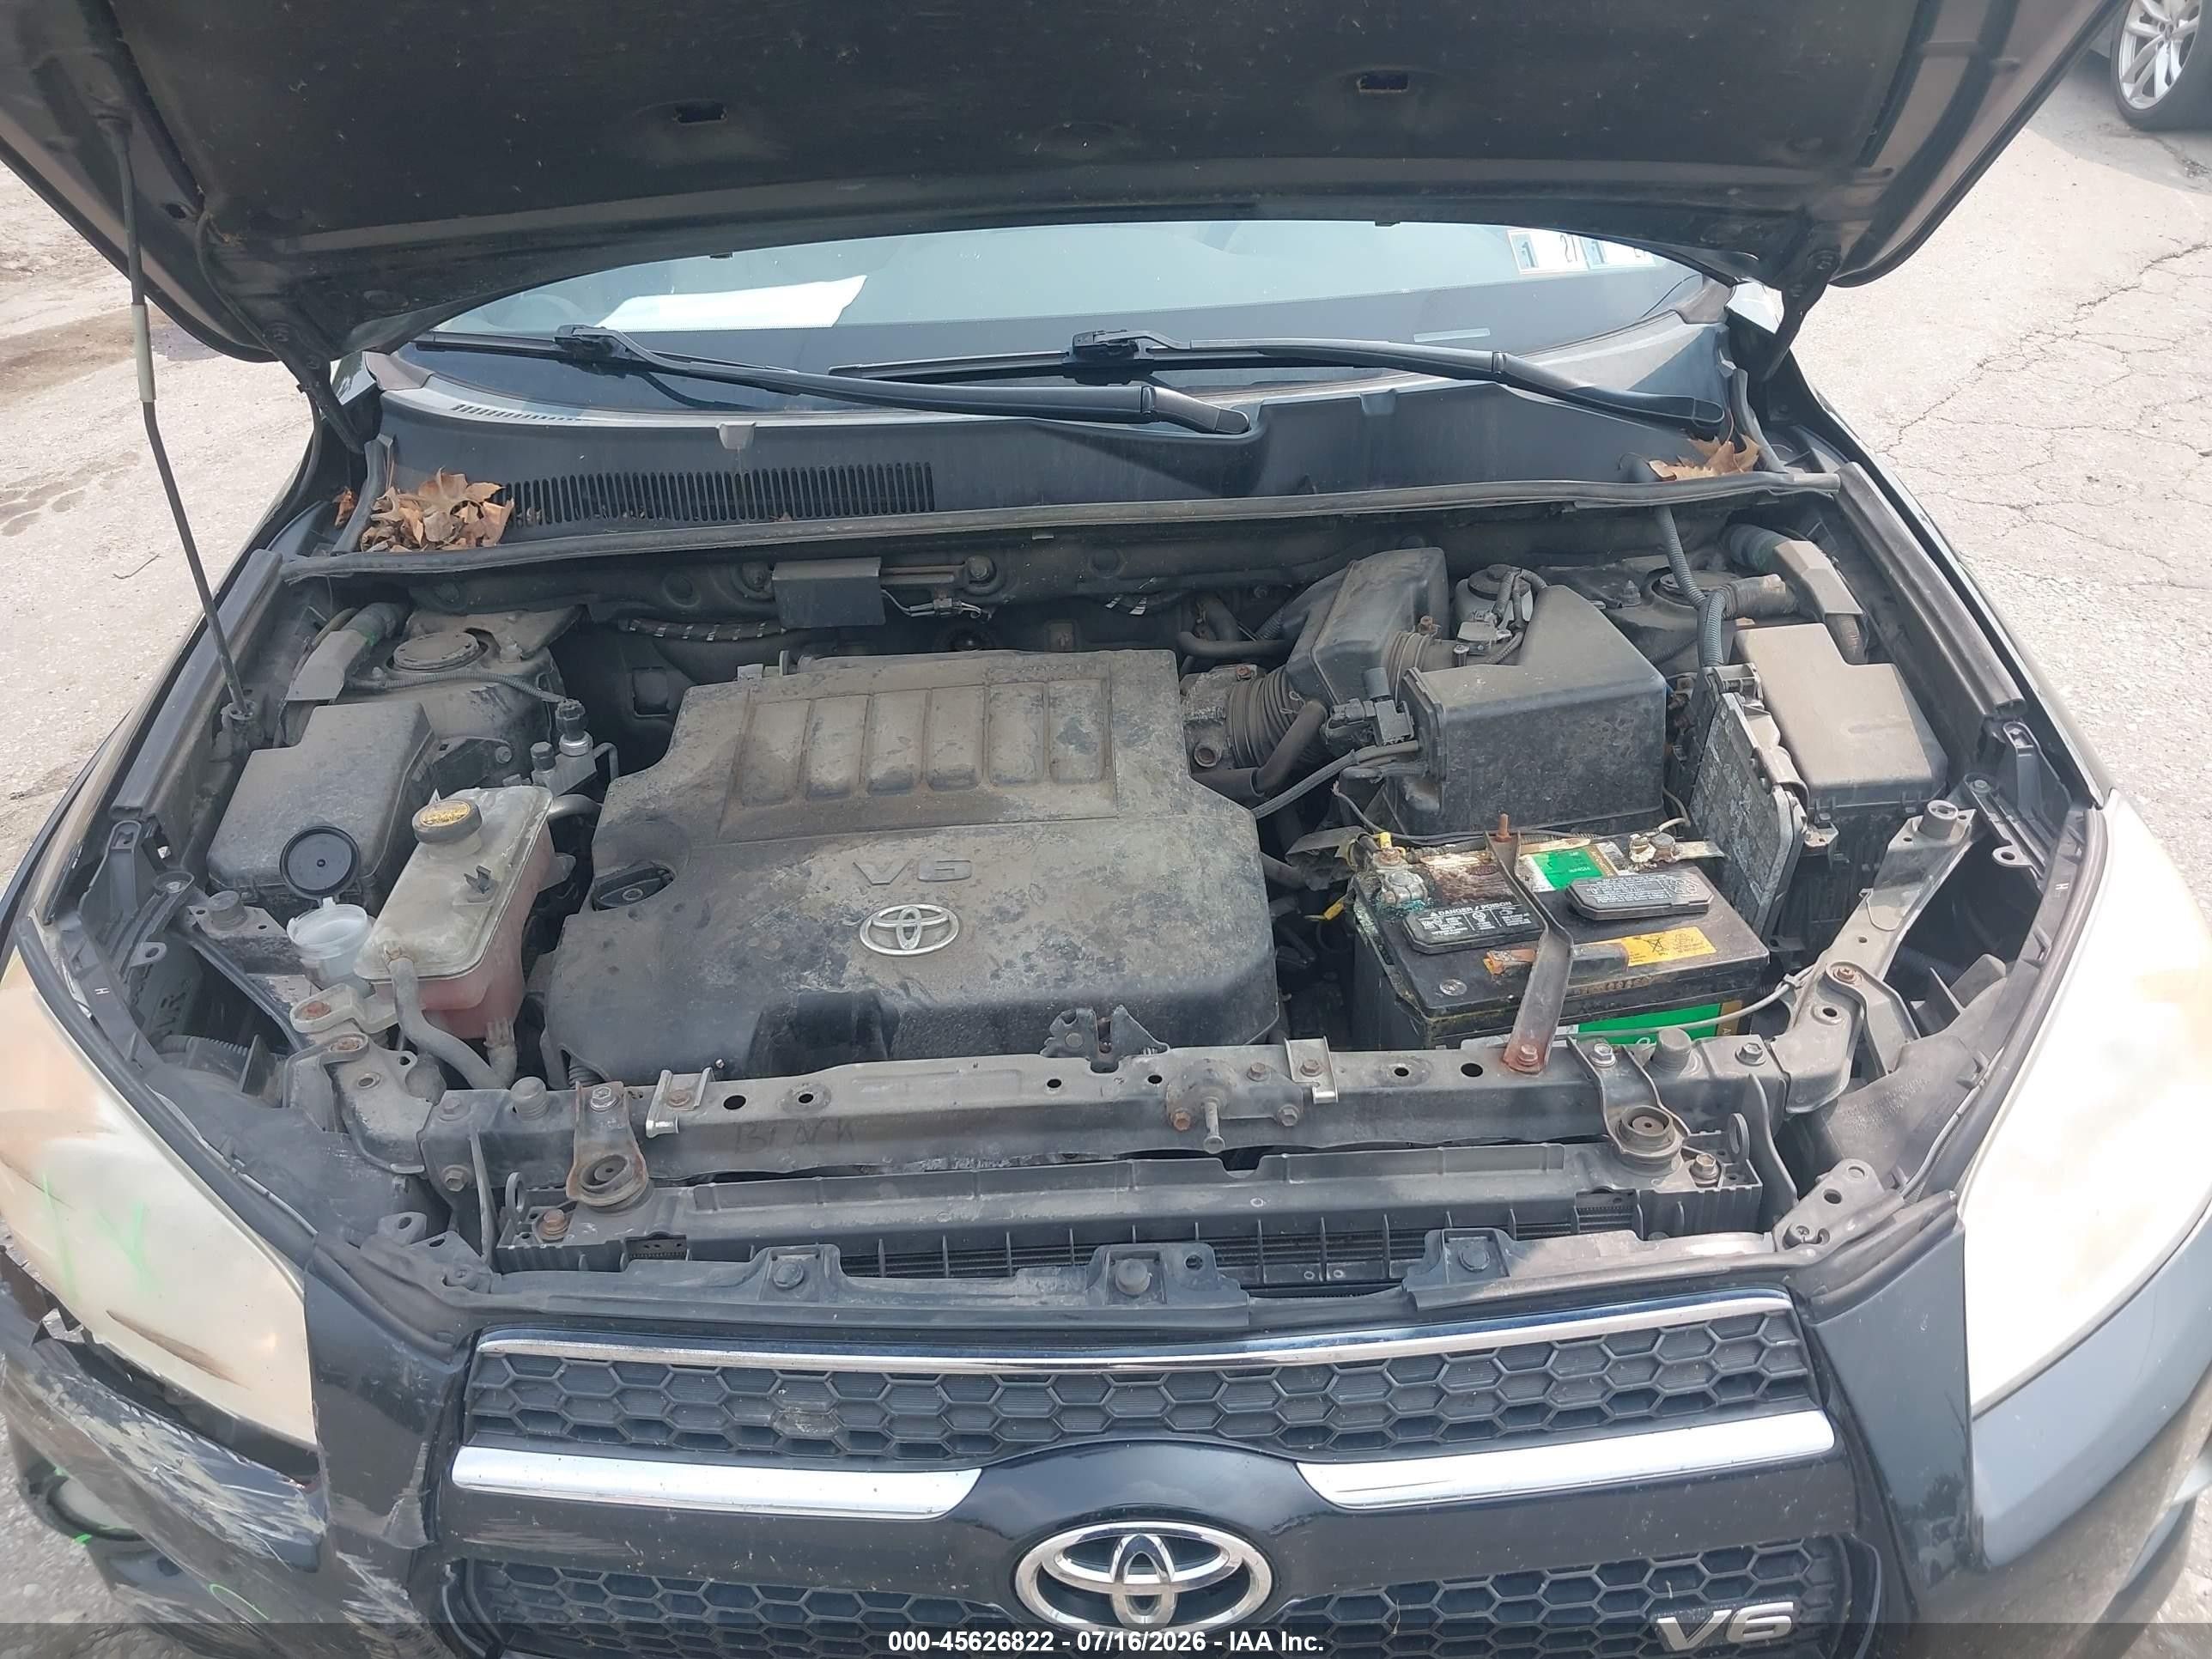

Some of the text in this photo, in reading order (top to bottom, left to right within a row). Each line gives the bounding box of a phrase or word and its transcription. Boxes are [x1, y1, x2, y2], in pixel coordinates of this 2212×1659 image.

[852, 859, 973, 885] V6
[1438, 907, 1474, 916] DANGER
[1480, 901, 1512, 910] POISON
[1656, 1601, 1795, 1651] V6
